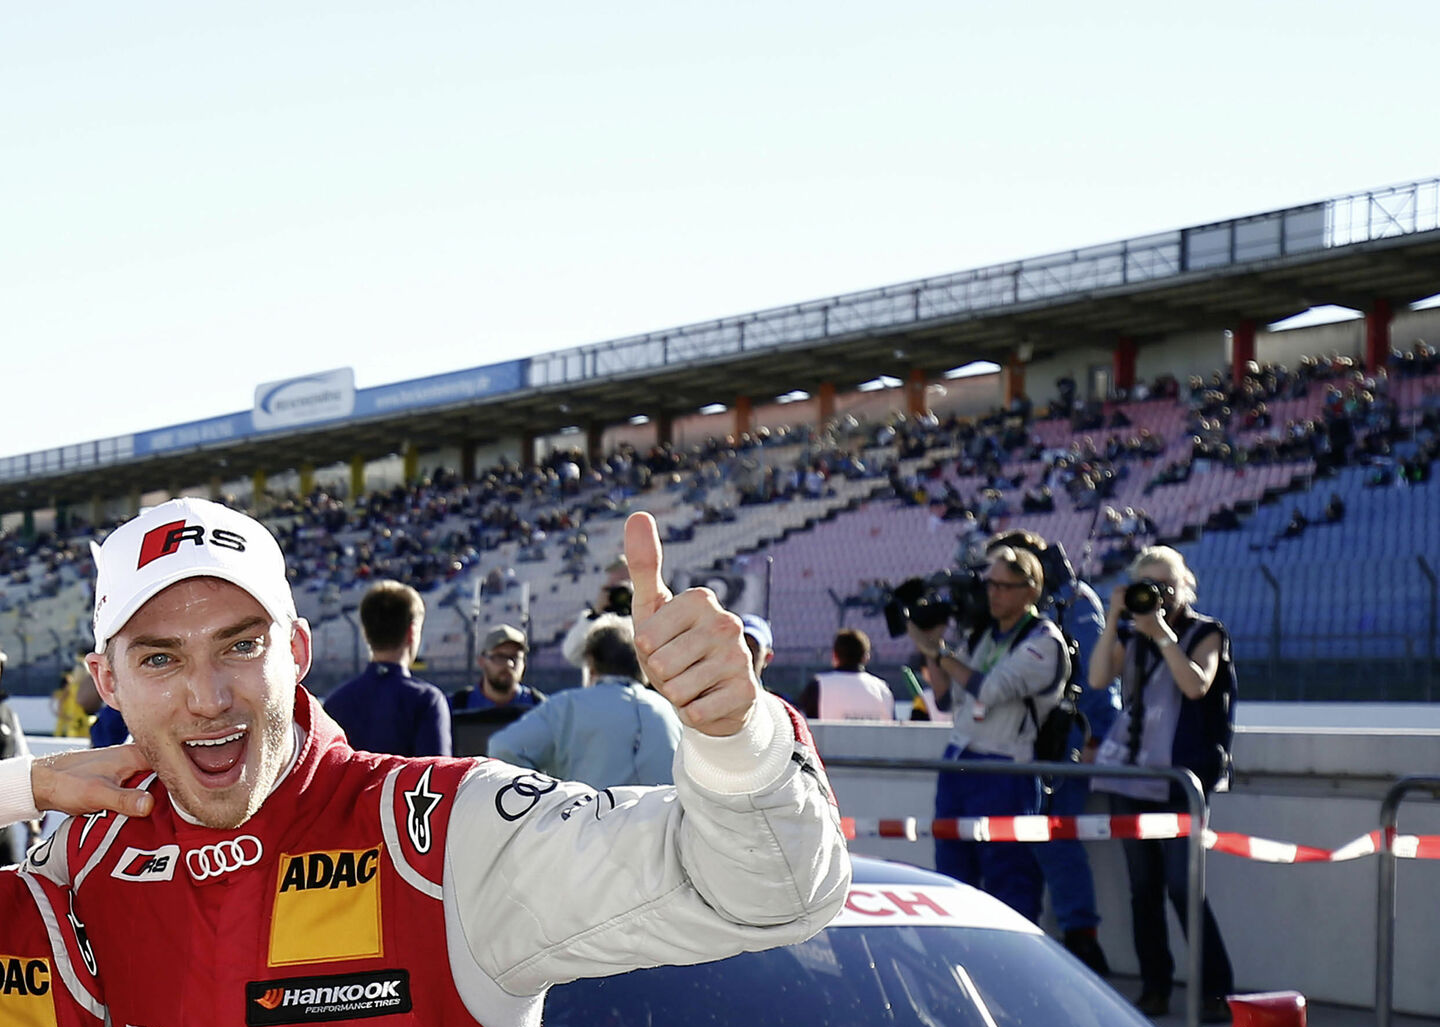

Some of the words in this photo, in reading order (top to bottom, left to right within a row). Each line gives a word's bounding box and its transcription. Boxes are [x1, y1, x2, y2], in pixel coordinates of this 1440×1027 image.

[279, 848, 379, 892] ADAC
[841, 890, 952, 916] CH
[305, 1001, 372, 1014] PERFORMANCE
[374, 998, 401, 1008] TIRES
